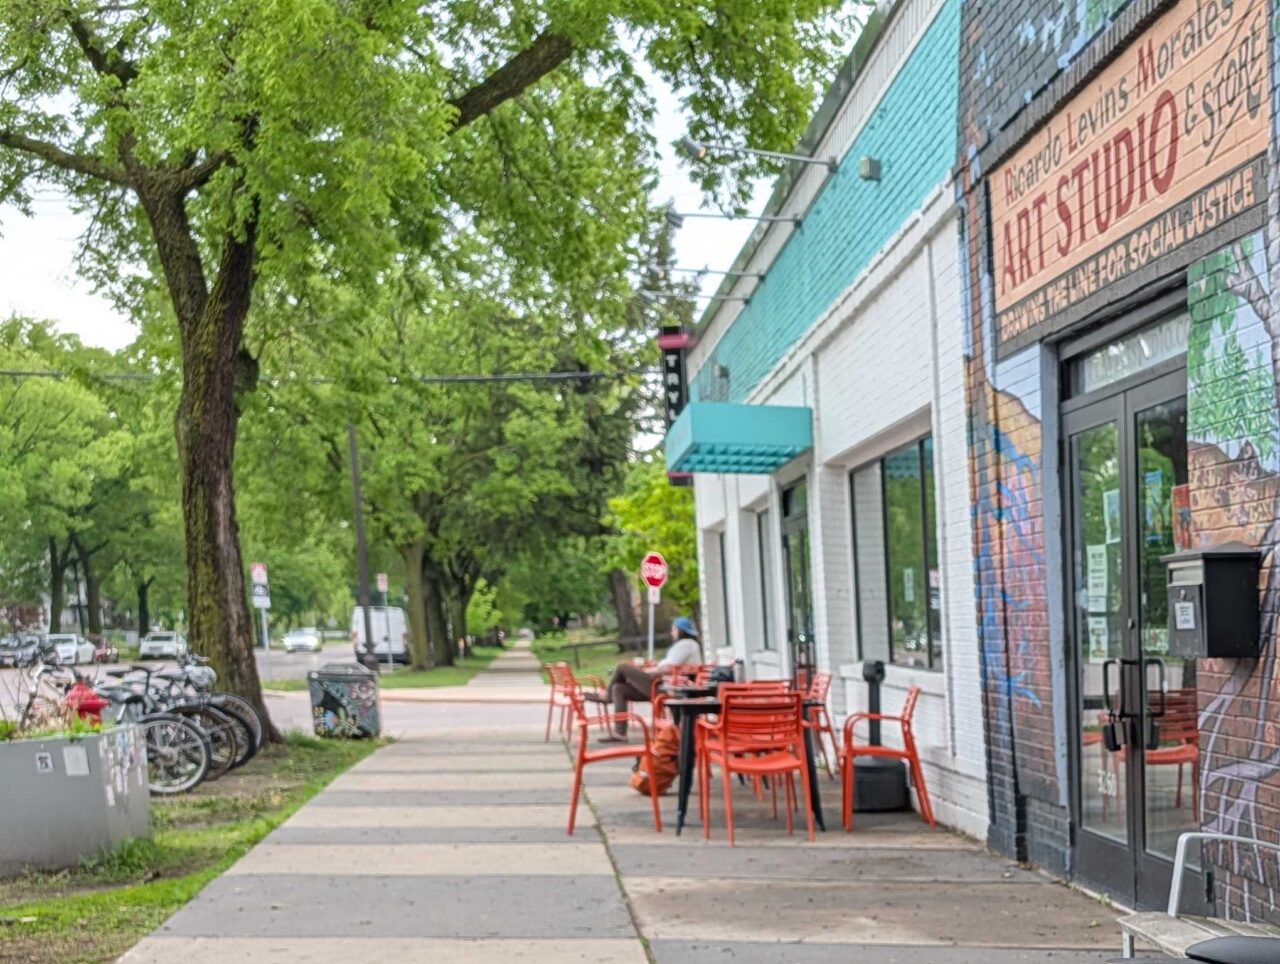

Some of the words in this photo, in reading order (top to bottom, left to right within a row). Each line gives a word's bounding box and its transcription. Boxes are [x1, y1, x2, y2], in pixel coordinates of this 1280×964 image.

[1001, 191, 1047, 295] ART
[1056, 89, 1178, 258] STUDIO
[1202, 9, 1263, 148] STORE
[1005, 126, 1062, 206] Ricardo
[1066, 77, 1129, 155] Levins
[1137, 0, 1234, 99] Morales
[1047, 278, 1069, 315] THE
[1069, 260, 1097, 303] LINE
[1098, 244, 1127, 287] FOR
[1129, 211, 1185, 271] SOCIAL
[1186, 166, 1255, 239] JUSTICE
